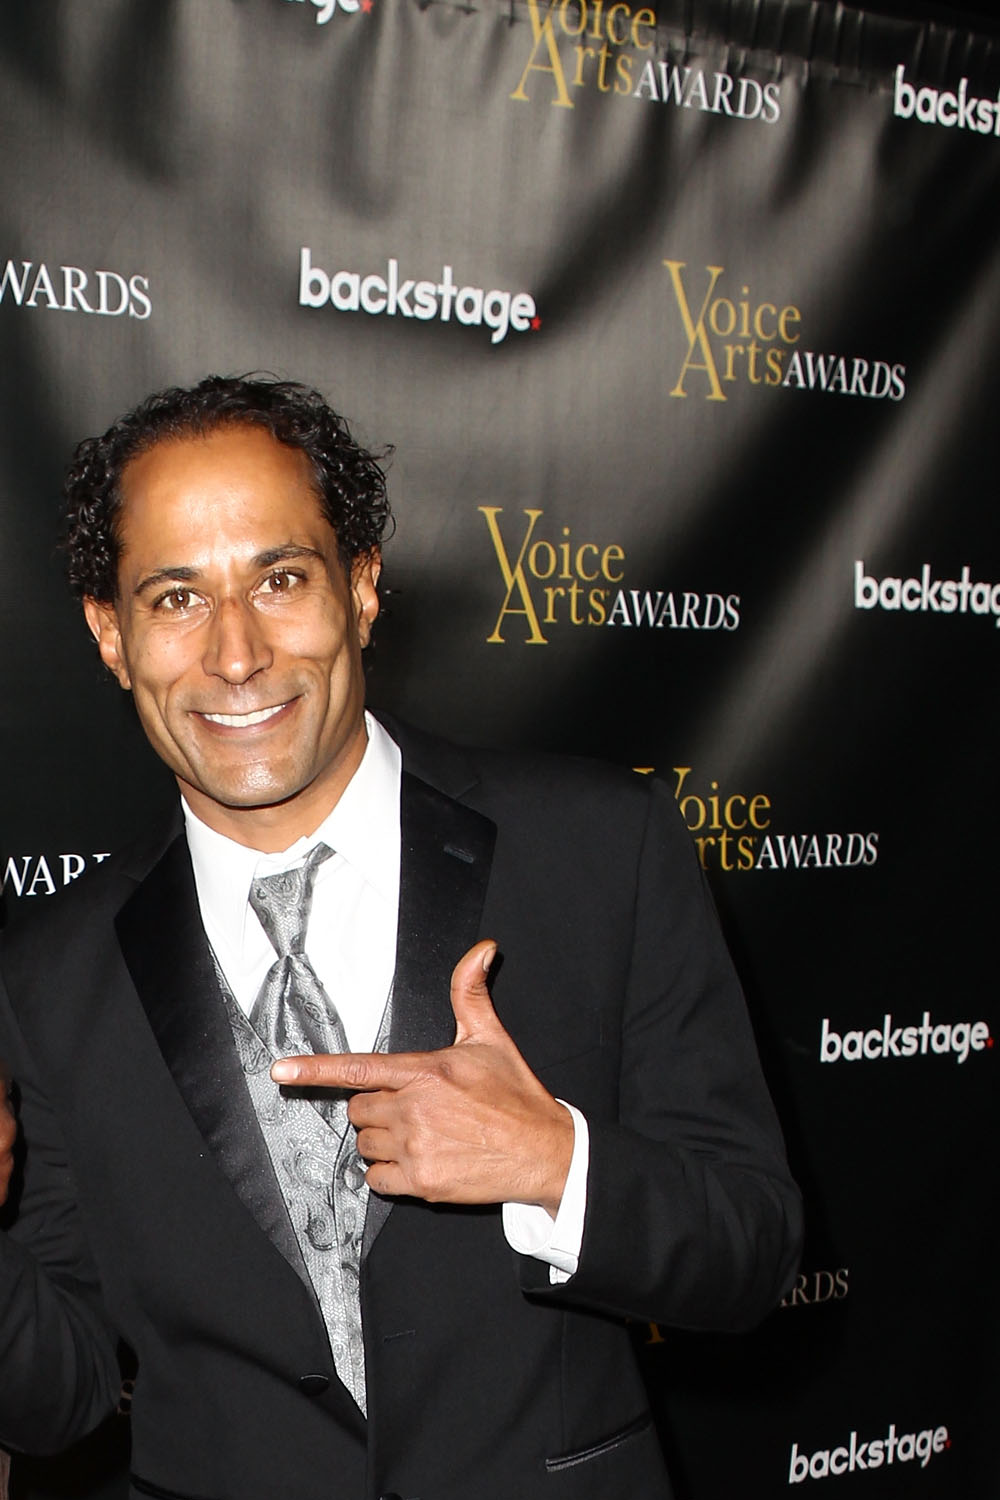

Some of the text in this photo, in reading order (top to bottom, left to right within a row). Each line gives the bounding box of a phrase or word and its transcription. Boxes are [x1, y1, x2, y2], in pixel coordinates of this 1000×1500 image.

[509, 15, 781, 124] Arts AWARDS
[299, 247, 537, 344] backstage
[663, 260, 801, 345] Voice
[669, 322, 906, 401] Arts AWARDS
[478, 506, 626, 590] Voice
[486, 563, 741, 645] Arts AWARDS
[755, 832, 879, 870] AWARDS
[820, 1011, 990, 1064] backstage
[788, 1424, 949, 1484] backstage
